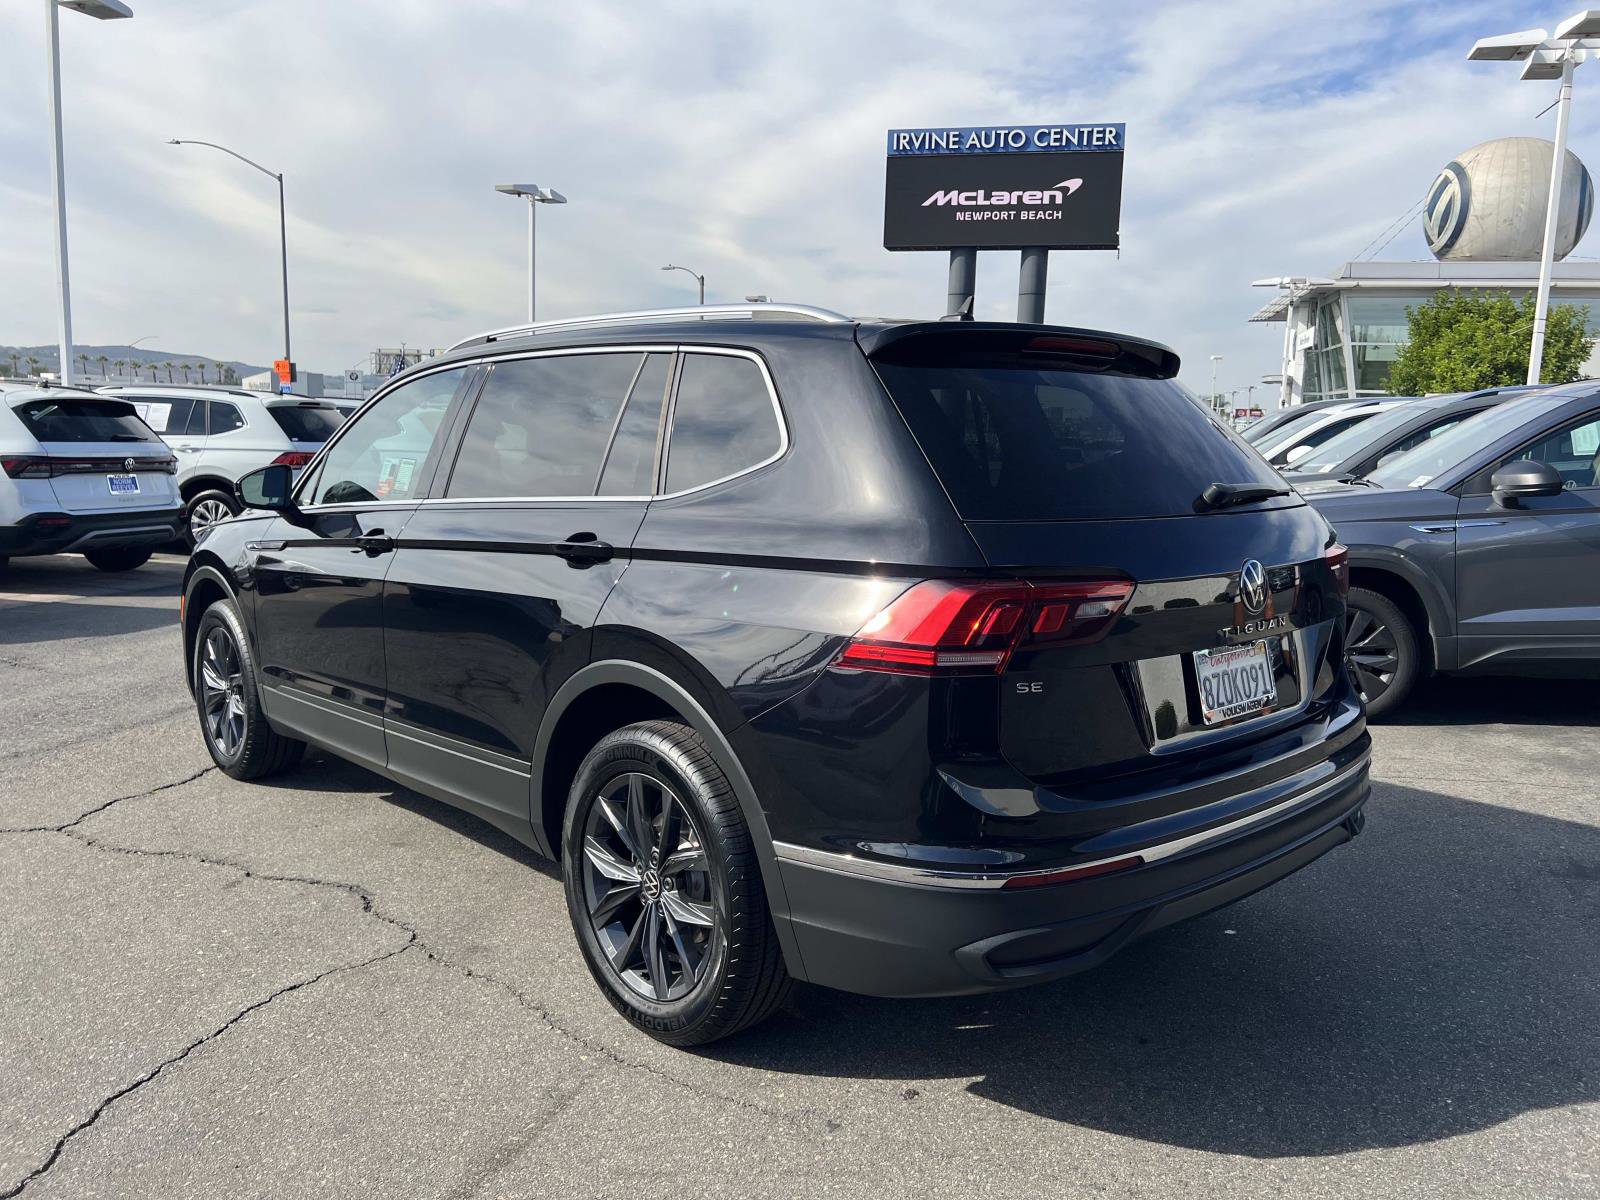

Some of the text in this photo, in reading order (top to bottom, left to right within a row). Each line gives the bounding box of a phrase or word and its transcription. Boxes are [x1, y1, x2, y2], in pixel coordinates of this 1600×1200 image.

[893, 127, 1118, 150] IRVINE AUTO CENTER
[921, 189, 1063, 207] McLaren
[956, 210, 1062, 221] NEWPORT BEACH
[1222, 616, 1286, 638] TIGUAN
[1016, 681, 1043, 693] SE
[1222, 700, 1262, 718] VOLKSWAGEN
